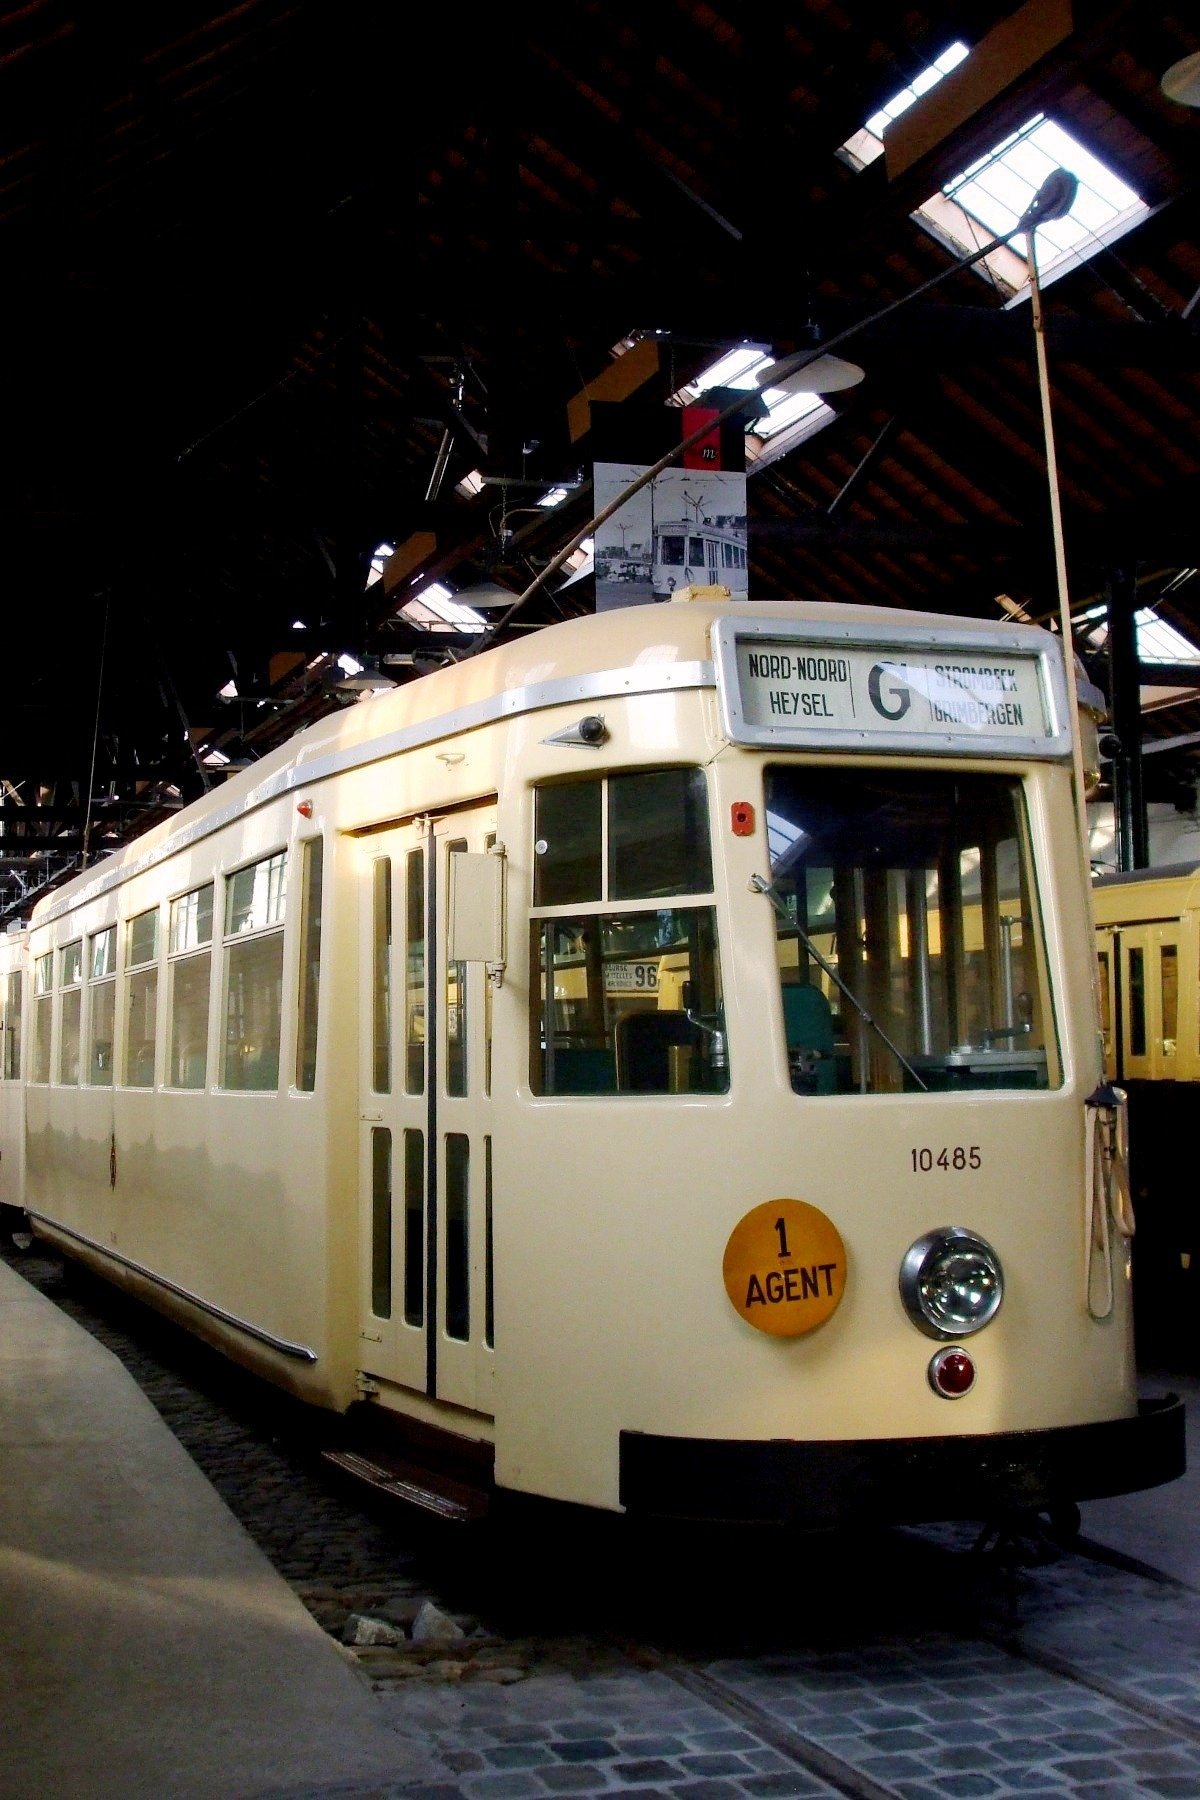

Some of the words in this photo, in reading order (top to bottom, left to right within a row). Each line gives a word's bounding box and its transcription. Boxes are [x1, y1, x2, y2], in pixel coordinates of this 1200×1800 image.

[749, 653, 848, 683] NORD-NOORD
[769, 691, 834, 718] HEYSEL
[868, 661, 911, 721] G
[635, 965, 657, 988] 96
[911, 1147, 982, 1173] 10485
[774, 1217, 791, 1258] 1
[745, 1263, 837, 1309] AGENT
